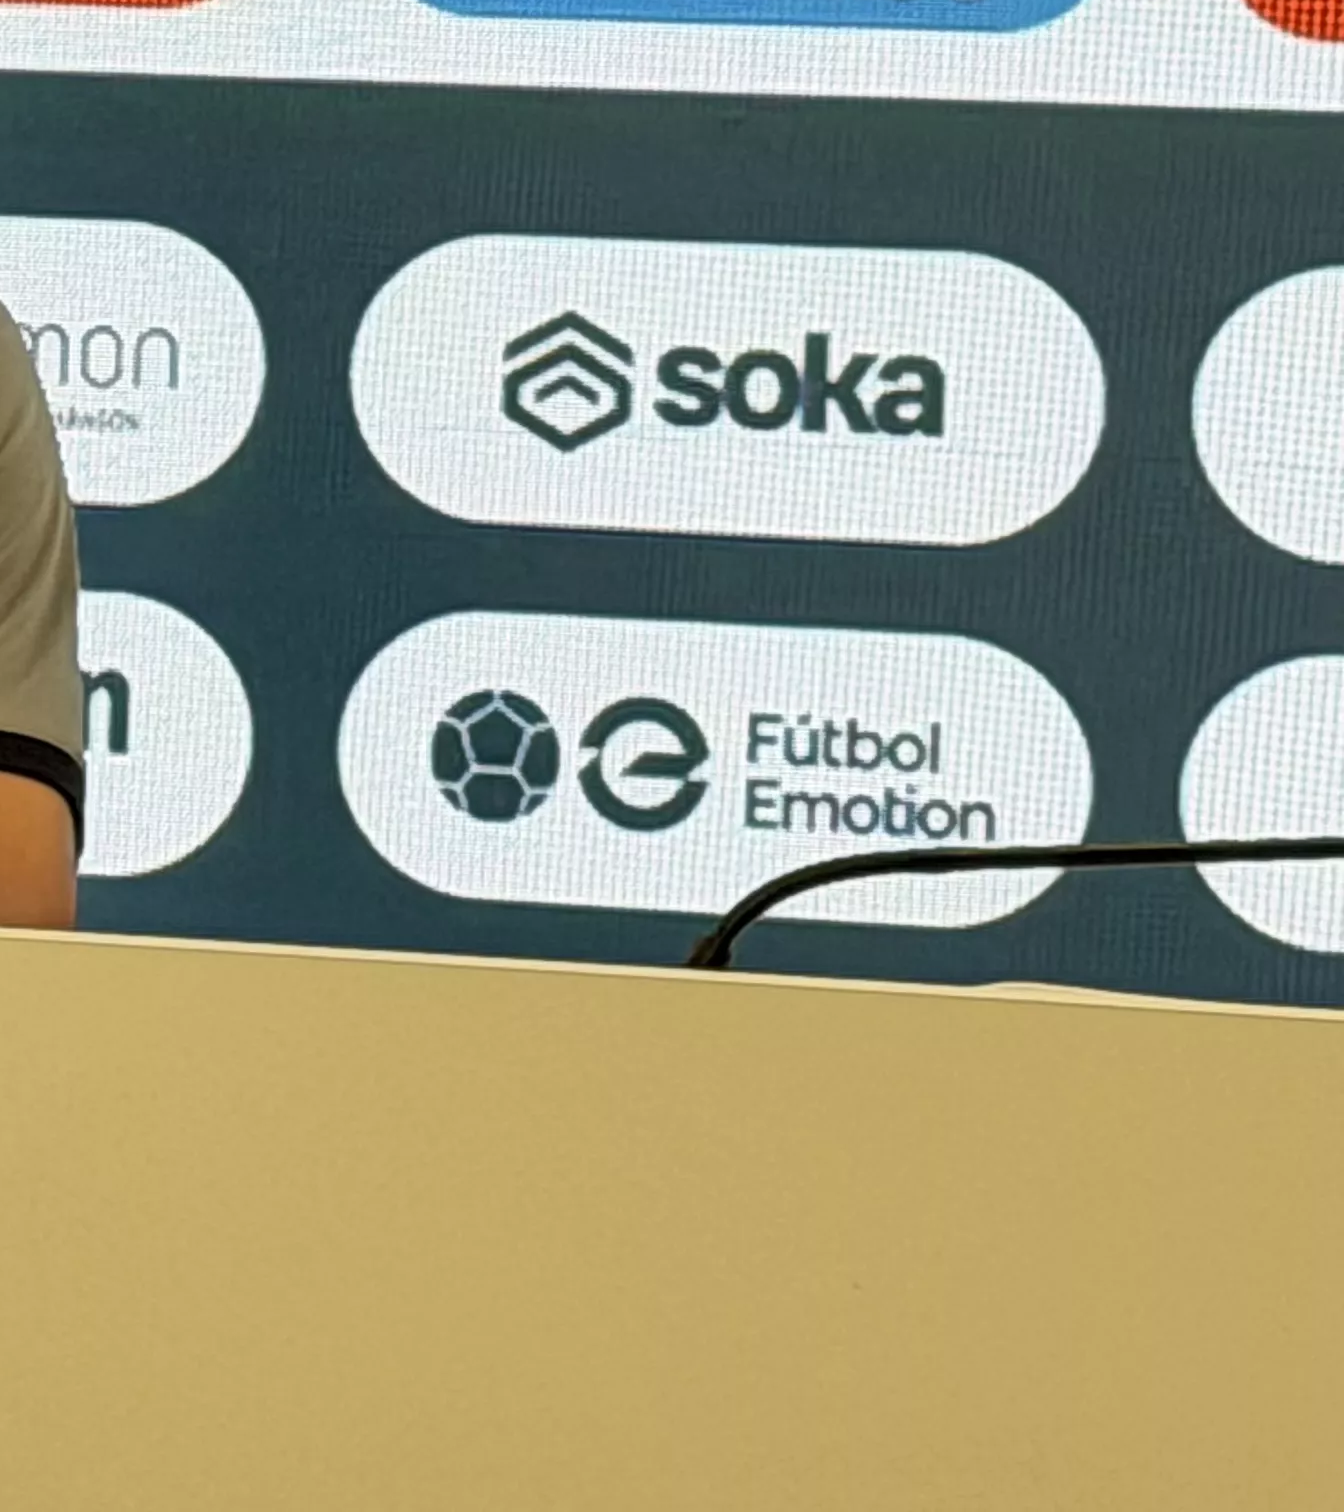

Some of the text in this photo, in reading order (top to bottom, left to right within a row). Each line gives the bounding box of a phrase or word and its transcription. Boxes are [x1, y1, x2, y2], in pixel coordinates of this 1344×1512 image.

[17, 323, 180, 390] mon
[654, 333, 945, 437] soka
[747, 713, 940, 773] Fútbol
[745, 779, 995, 841] Emotion
